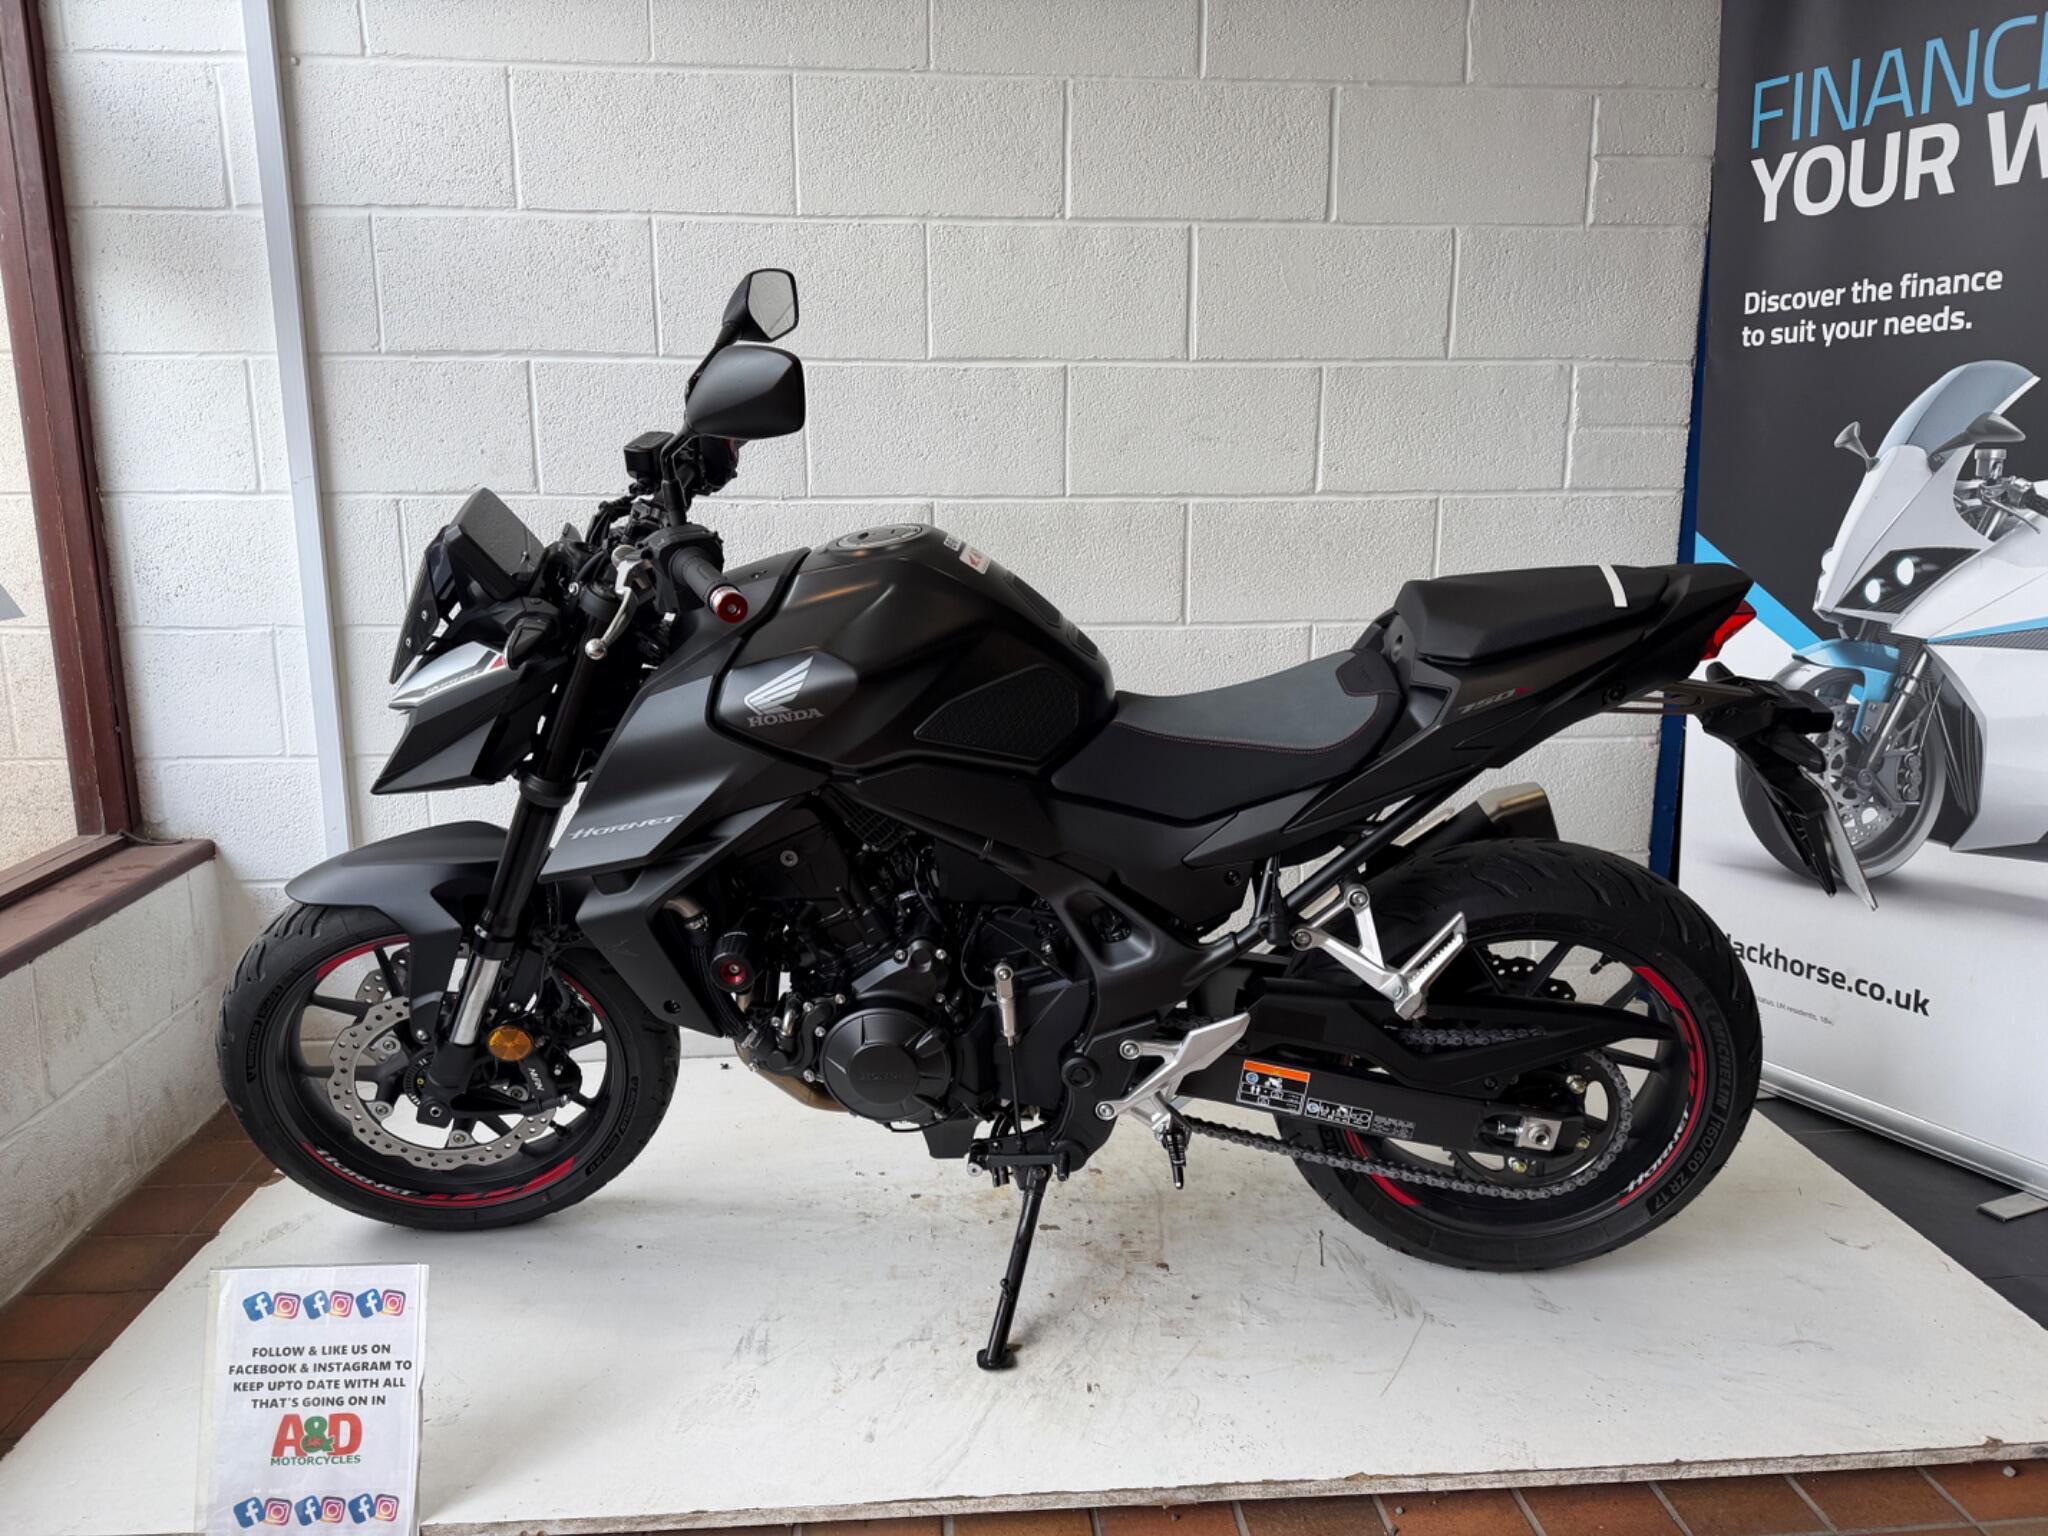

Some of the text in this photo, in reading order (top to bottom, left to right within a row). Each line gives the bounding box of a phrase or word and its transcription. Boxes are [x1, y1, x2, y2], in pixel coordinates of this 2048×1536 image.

[1751, 11, 2048, 149] FINANC
[1751, 123, 1960, 223] YOUR
[1744, 269, 2003, 315] Discover the finance
[1742, 305, 1973, 347] to suit your needs.
[747, 708, 824, 728] HONDA
[568, 814, 685, 840] HORNET
[1727, 933, 1930, 1017] ackhorse.co.uk
[1711, 1022, 1734, 1110] MICHELIN
[1620, 1102, 1689, 1194] HORNET
[1655, 1119, 1723, 1210] 160/60 ZR 17
[229, 1360, 412, 1375] FACEBOOK & INSTAGRAM TO
[252, 1344, 391, 1358] FOLLOW & LIKE US ON
[233, 1377, 406, 1392] KEEP UPTO DATE WITH ALL
[251, 1395, 386, 1409] THAT'S GOING ON IN
[271, 1412, 363, 1458] A&D
[270, 1455, 361, 1466] MOTORCYCLES
